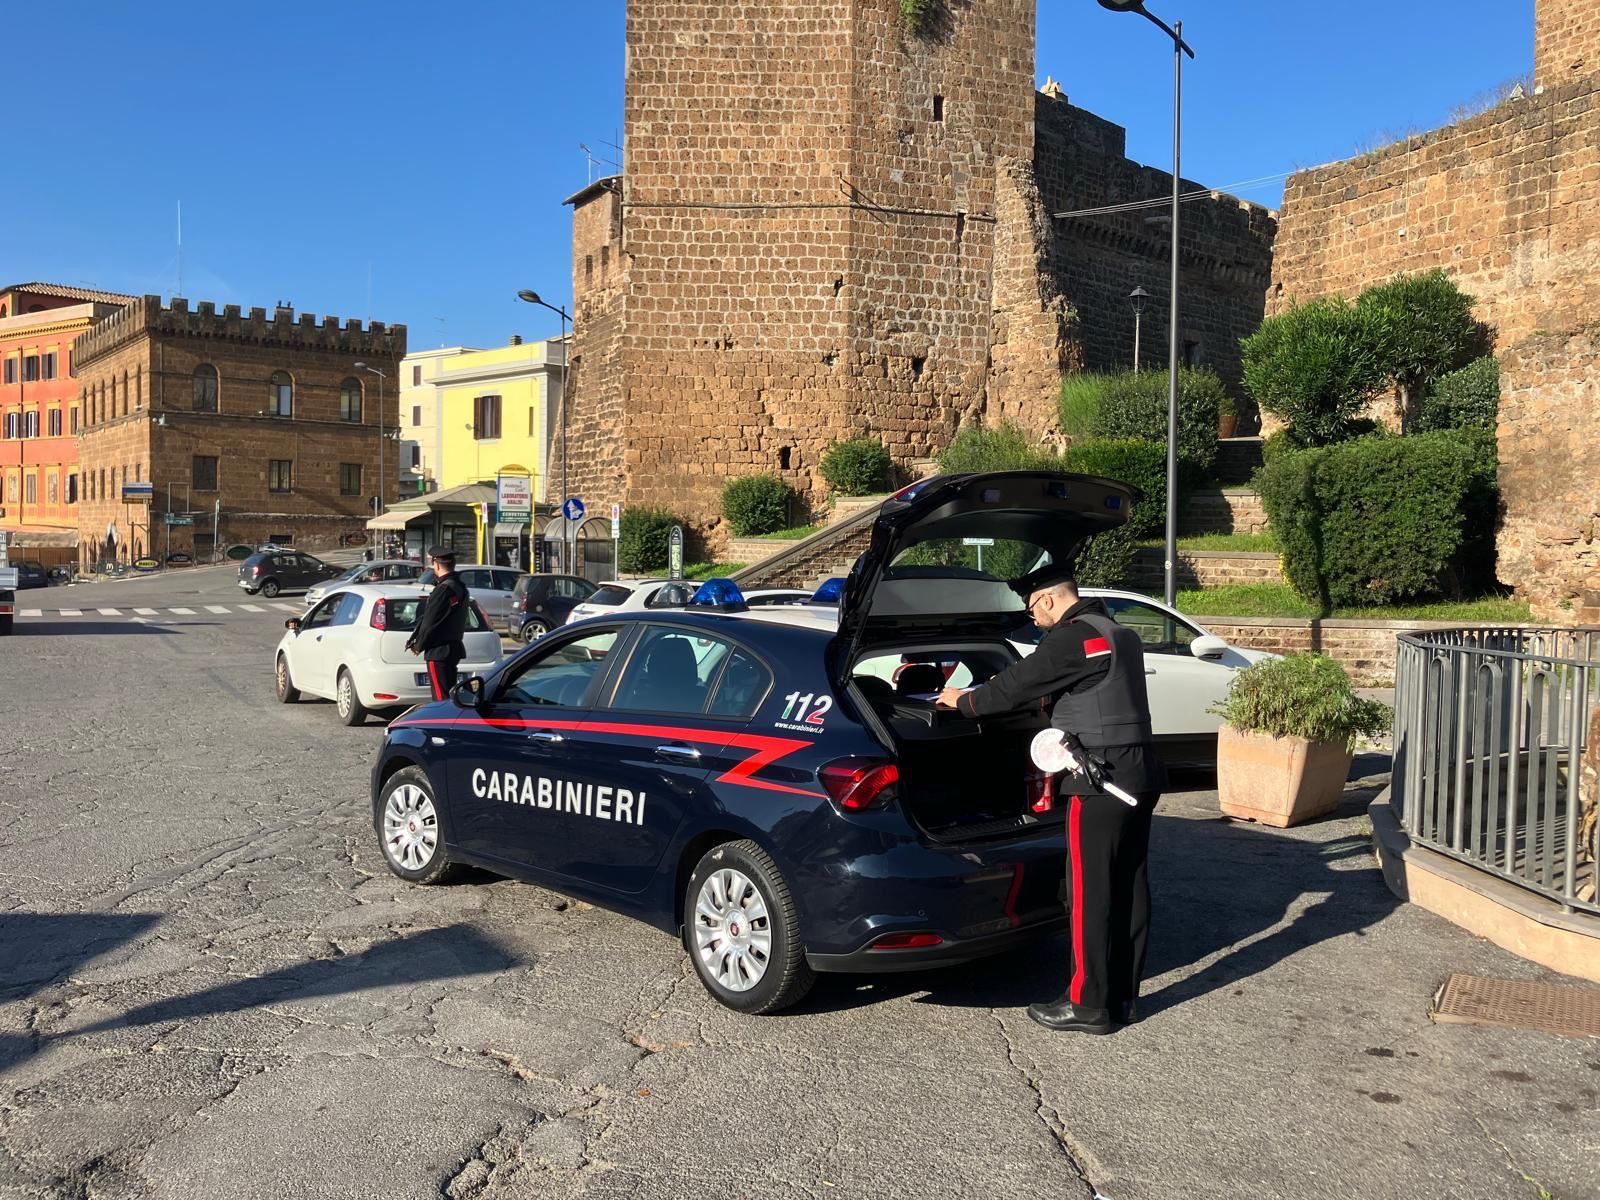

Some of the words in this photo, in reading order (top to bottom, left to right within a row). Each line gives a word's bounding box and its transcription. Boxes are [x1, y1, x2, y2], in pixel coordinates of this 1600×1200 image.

[781, 691, 833, 725] 112
[774, 721, 825, 734] www.carabinieri.it
[472, 767, 647, 826] CARABINIERI
